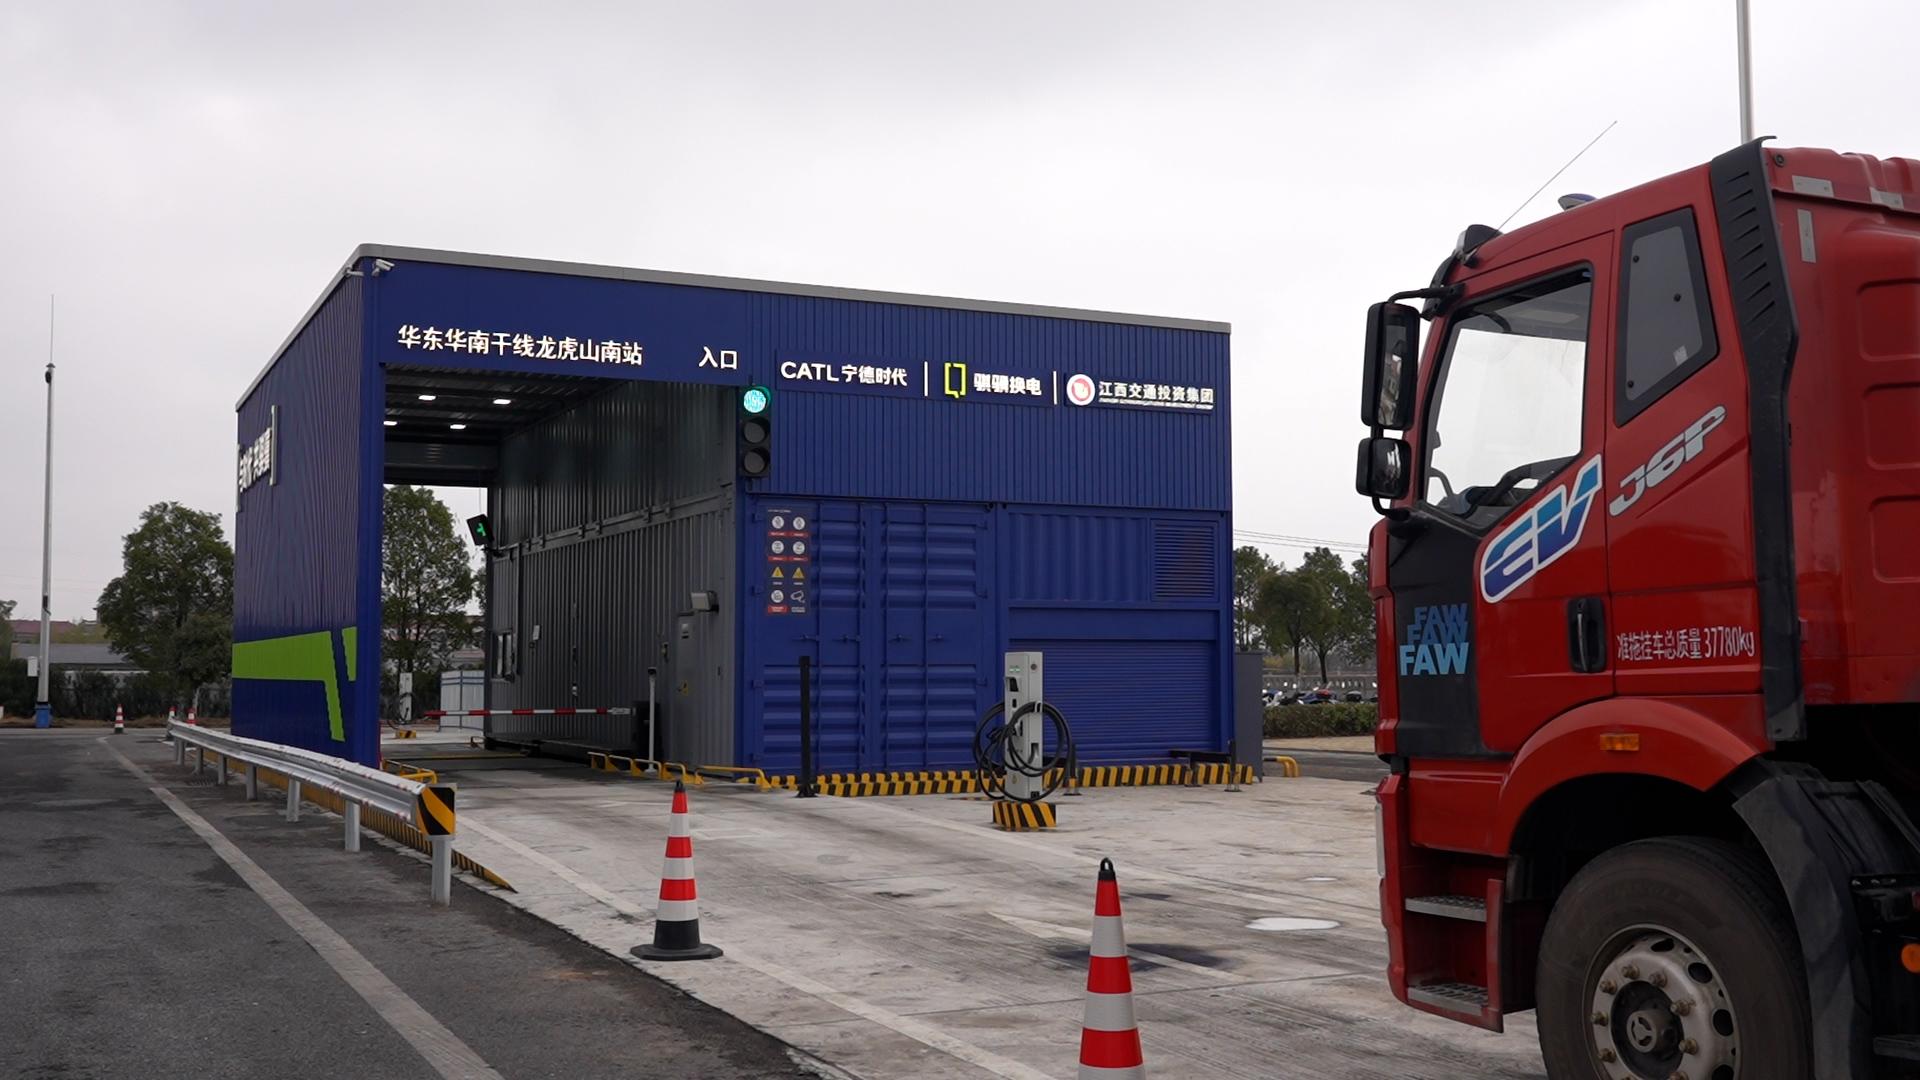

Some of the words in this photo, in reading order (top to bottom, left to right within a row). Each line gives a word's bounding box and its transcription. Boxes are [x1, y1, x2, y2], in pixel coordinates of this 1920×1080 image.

[398, 325, 643, 366] 华东华南干线龙虎山南站
[699, 347, 738, 370] 入口
[781, 361, 840, 383] CATL
[842, 364, 908, 386] 宁德时代
[1099, 381, 1214, 403] 江西交通投资集团
[1609, 406, 1726, 517] J6P
[1480, 453, 1603, 604] EV
[1414, 603, 1468, 627] FAW
[1407, 621, 1468, 646] FAW
[1399, 642, 1469, 676] FAW
